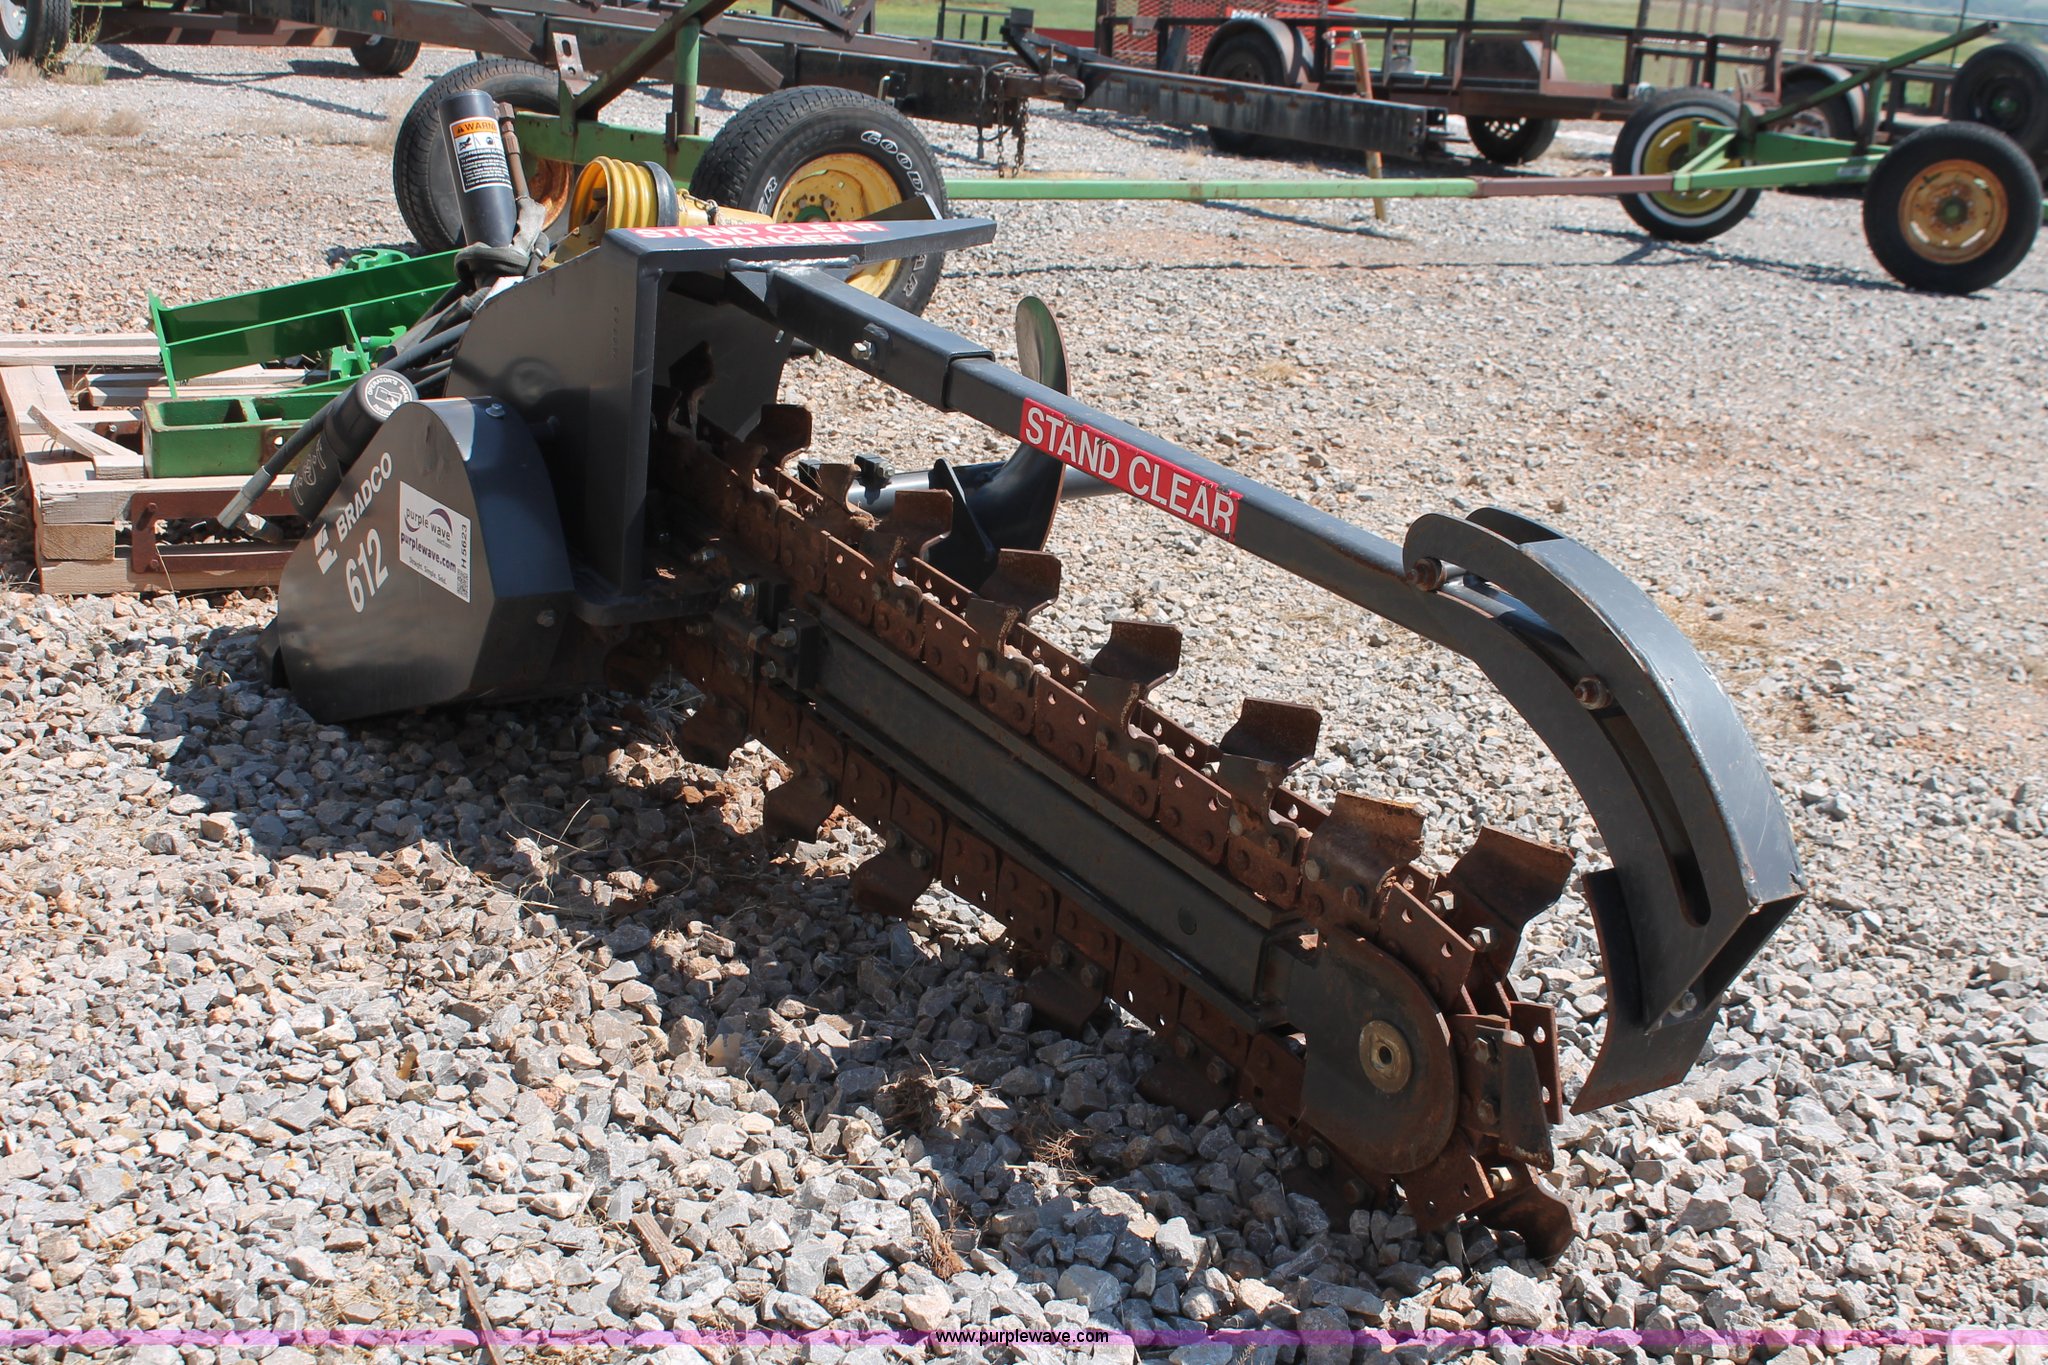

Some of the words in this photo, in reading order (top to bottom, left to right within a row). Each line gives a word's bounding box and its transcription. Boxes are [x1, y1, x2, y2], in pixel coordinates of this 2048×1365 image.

[635, 226, 755, 240] STAND
[771, 222, 886, 235] CLEAR
[702, 232, 857, 247] DANGER
[1025, 407, 1120, 480] STAND
[1128, 455, 1234, 535] CLEAR
[336, 452, 392, 543] BRADCO
[405, 507, 429, 530] purple
[430, 521, 451, 542] wave
[346, 528, 389, 613] 612
[400, 531, 457, 574] purplewave.com
